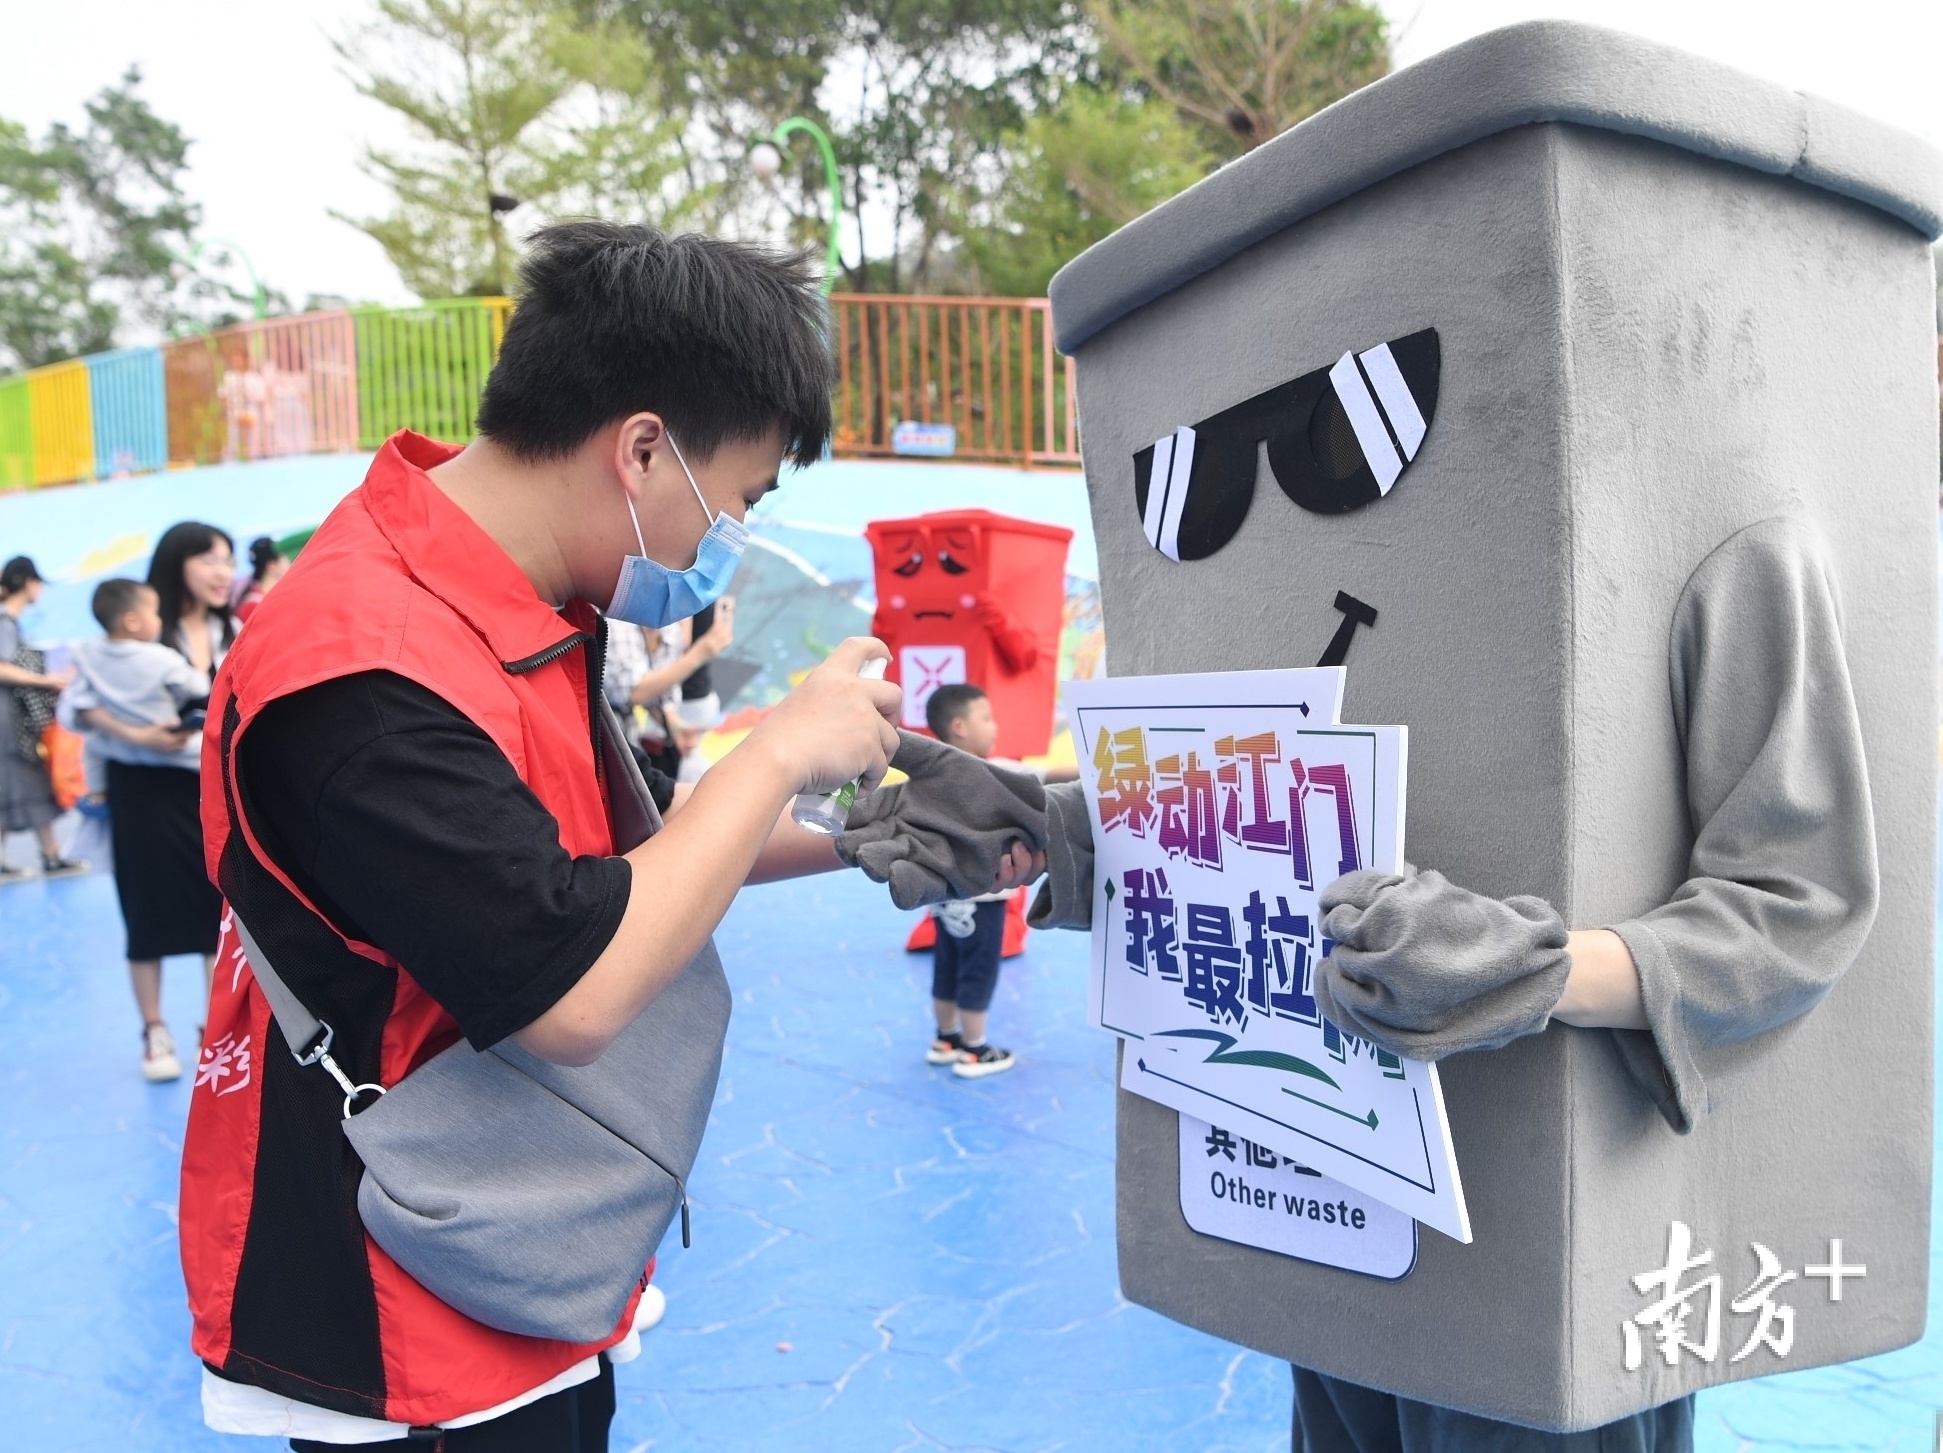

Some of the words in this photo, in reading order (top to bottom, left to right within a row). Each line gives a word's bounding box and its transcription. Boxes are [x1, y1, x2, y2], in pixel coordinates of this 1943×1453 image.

[1093, 725, 1362, 892] 绿动江门
[1123, 866, 1406, 1081] 我最拉
[195, 1031, 251, 1097] 彩
[1210, 1171, 1277, 1210] Other
[1283, 1193, 1366, 1230] waste
